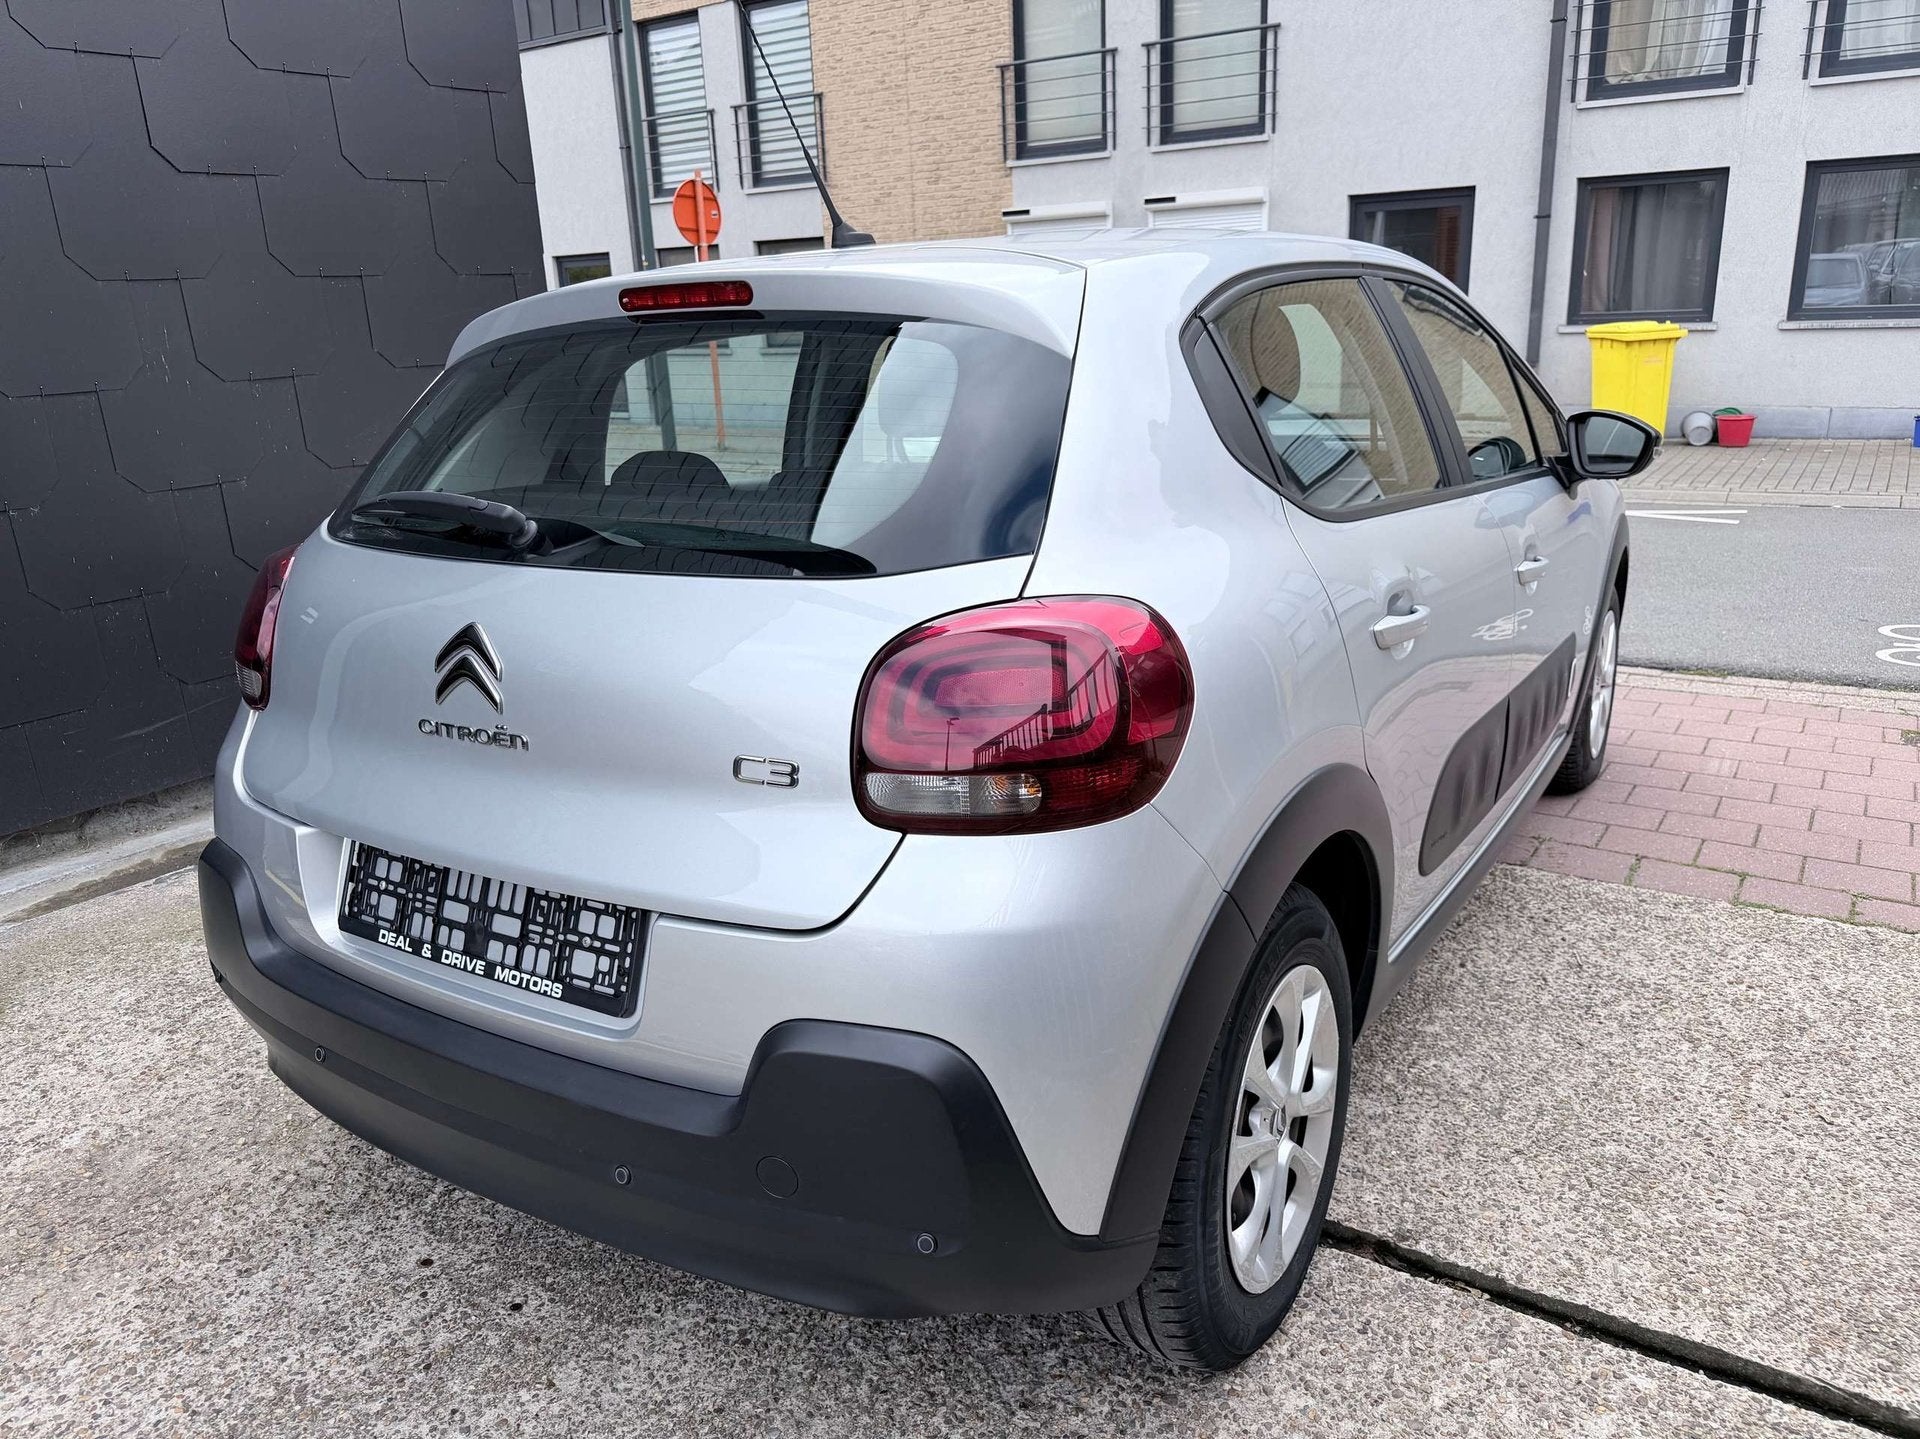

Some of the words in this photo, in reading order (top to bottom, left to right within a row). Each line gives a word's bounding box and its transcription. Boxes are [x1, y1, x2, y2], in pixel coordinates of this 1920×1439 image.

[732, 754, 800, 789] C3
[378, 929, 413, 954] DEAL
[421, 943, 432, 958] &
[441, 949, 486, 976] DRIVE
[494, 965, 563, 999] MOTORS
